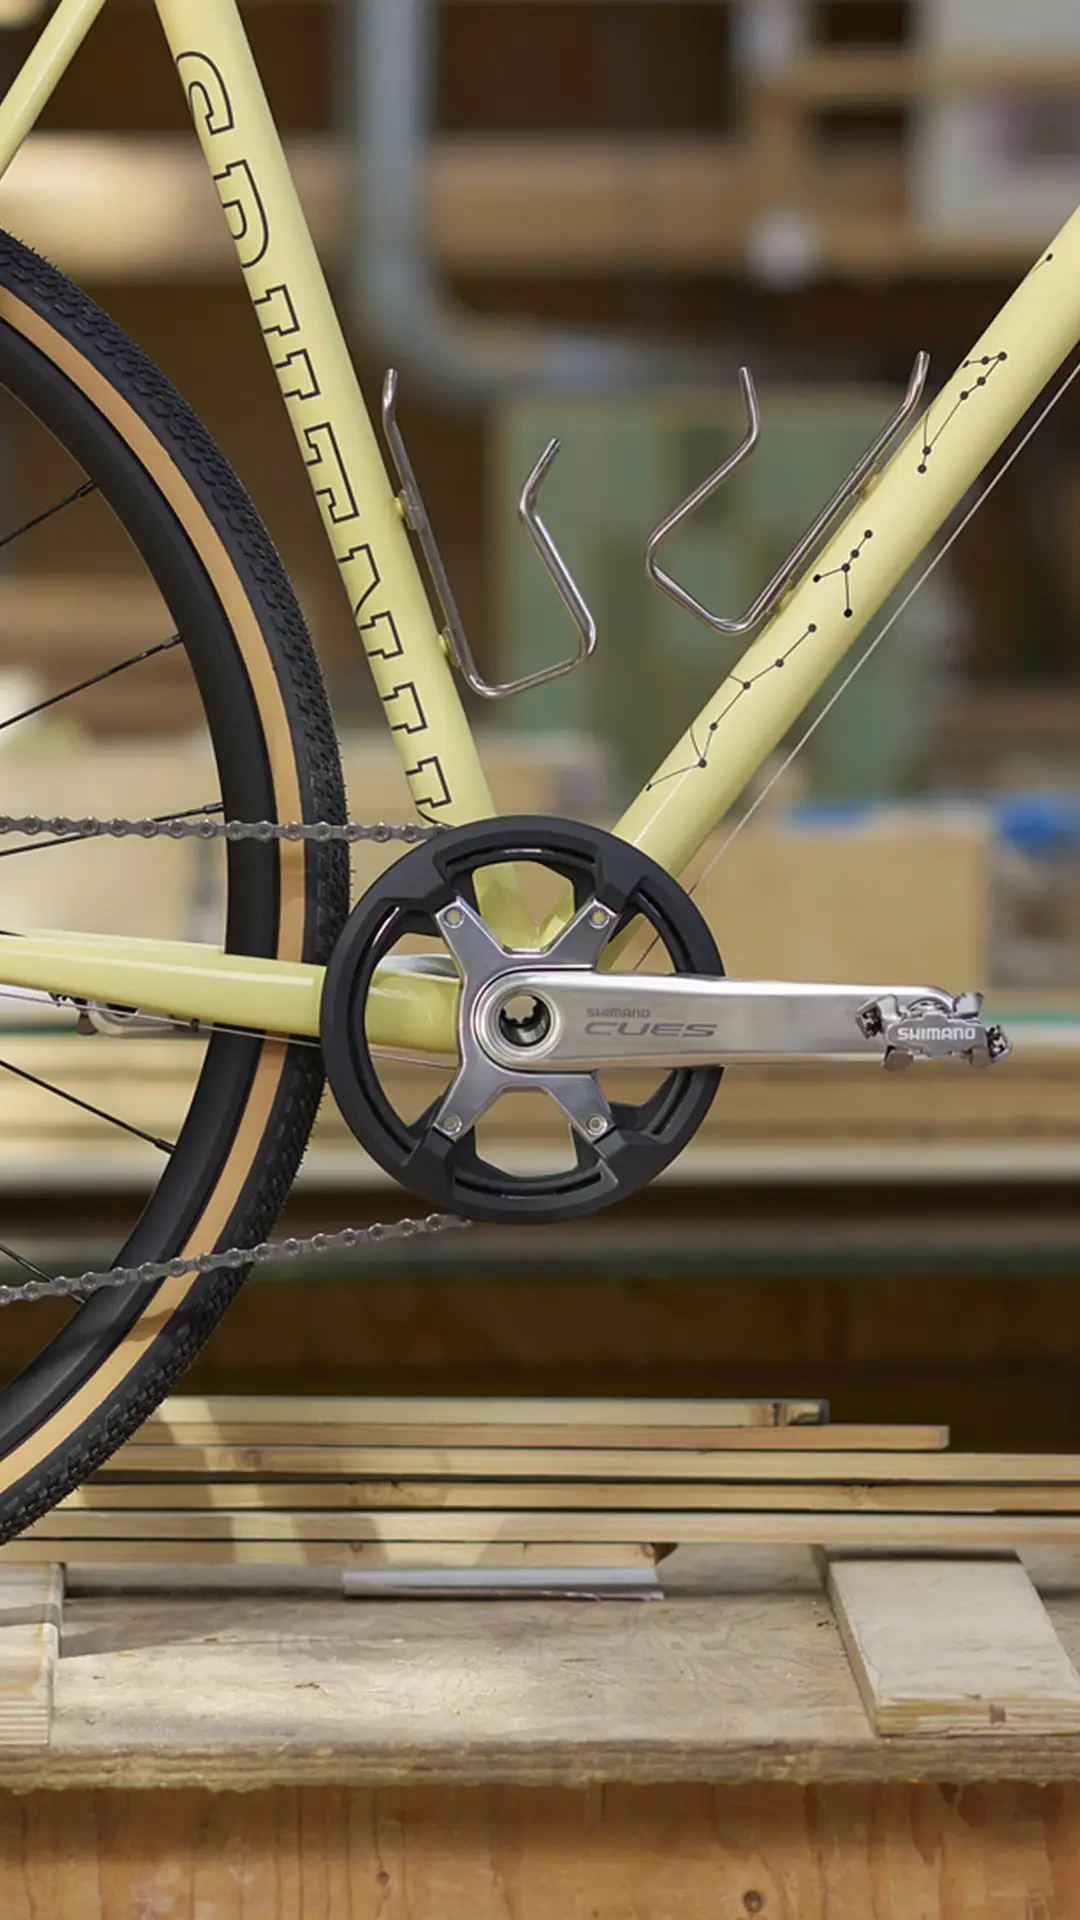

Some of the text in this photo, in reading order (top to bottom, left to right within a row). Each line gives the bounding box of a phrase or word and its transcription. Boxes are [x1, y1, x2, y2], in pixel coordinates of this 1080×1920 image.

[586, 1007, 651, 1018] SHIMANO
[584, 1022, 718, 1037] CUES
[897, 1027, 976, 1041] SHIMANO
